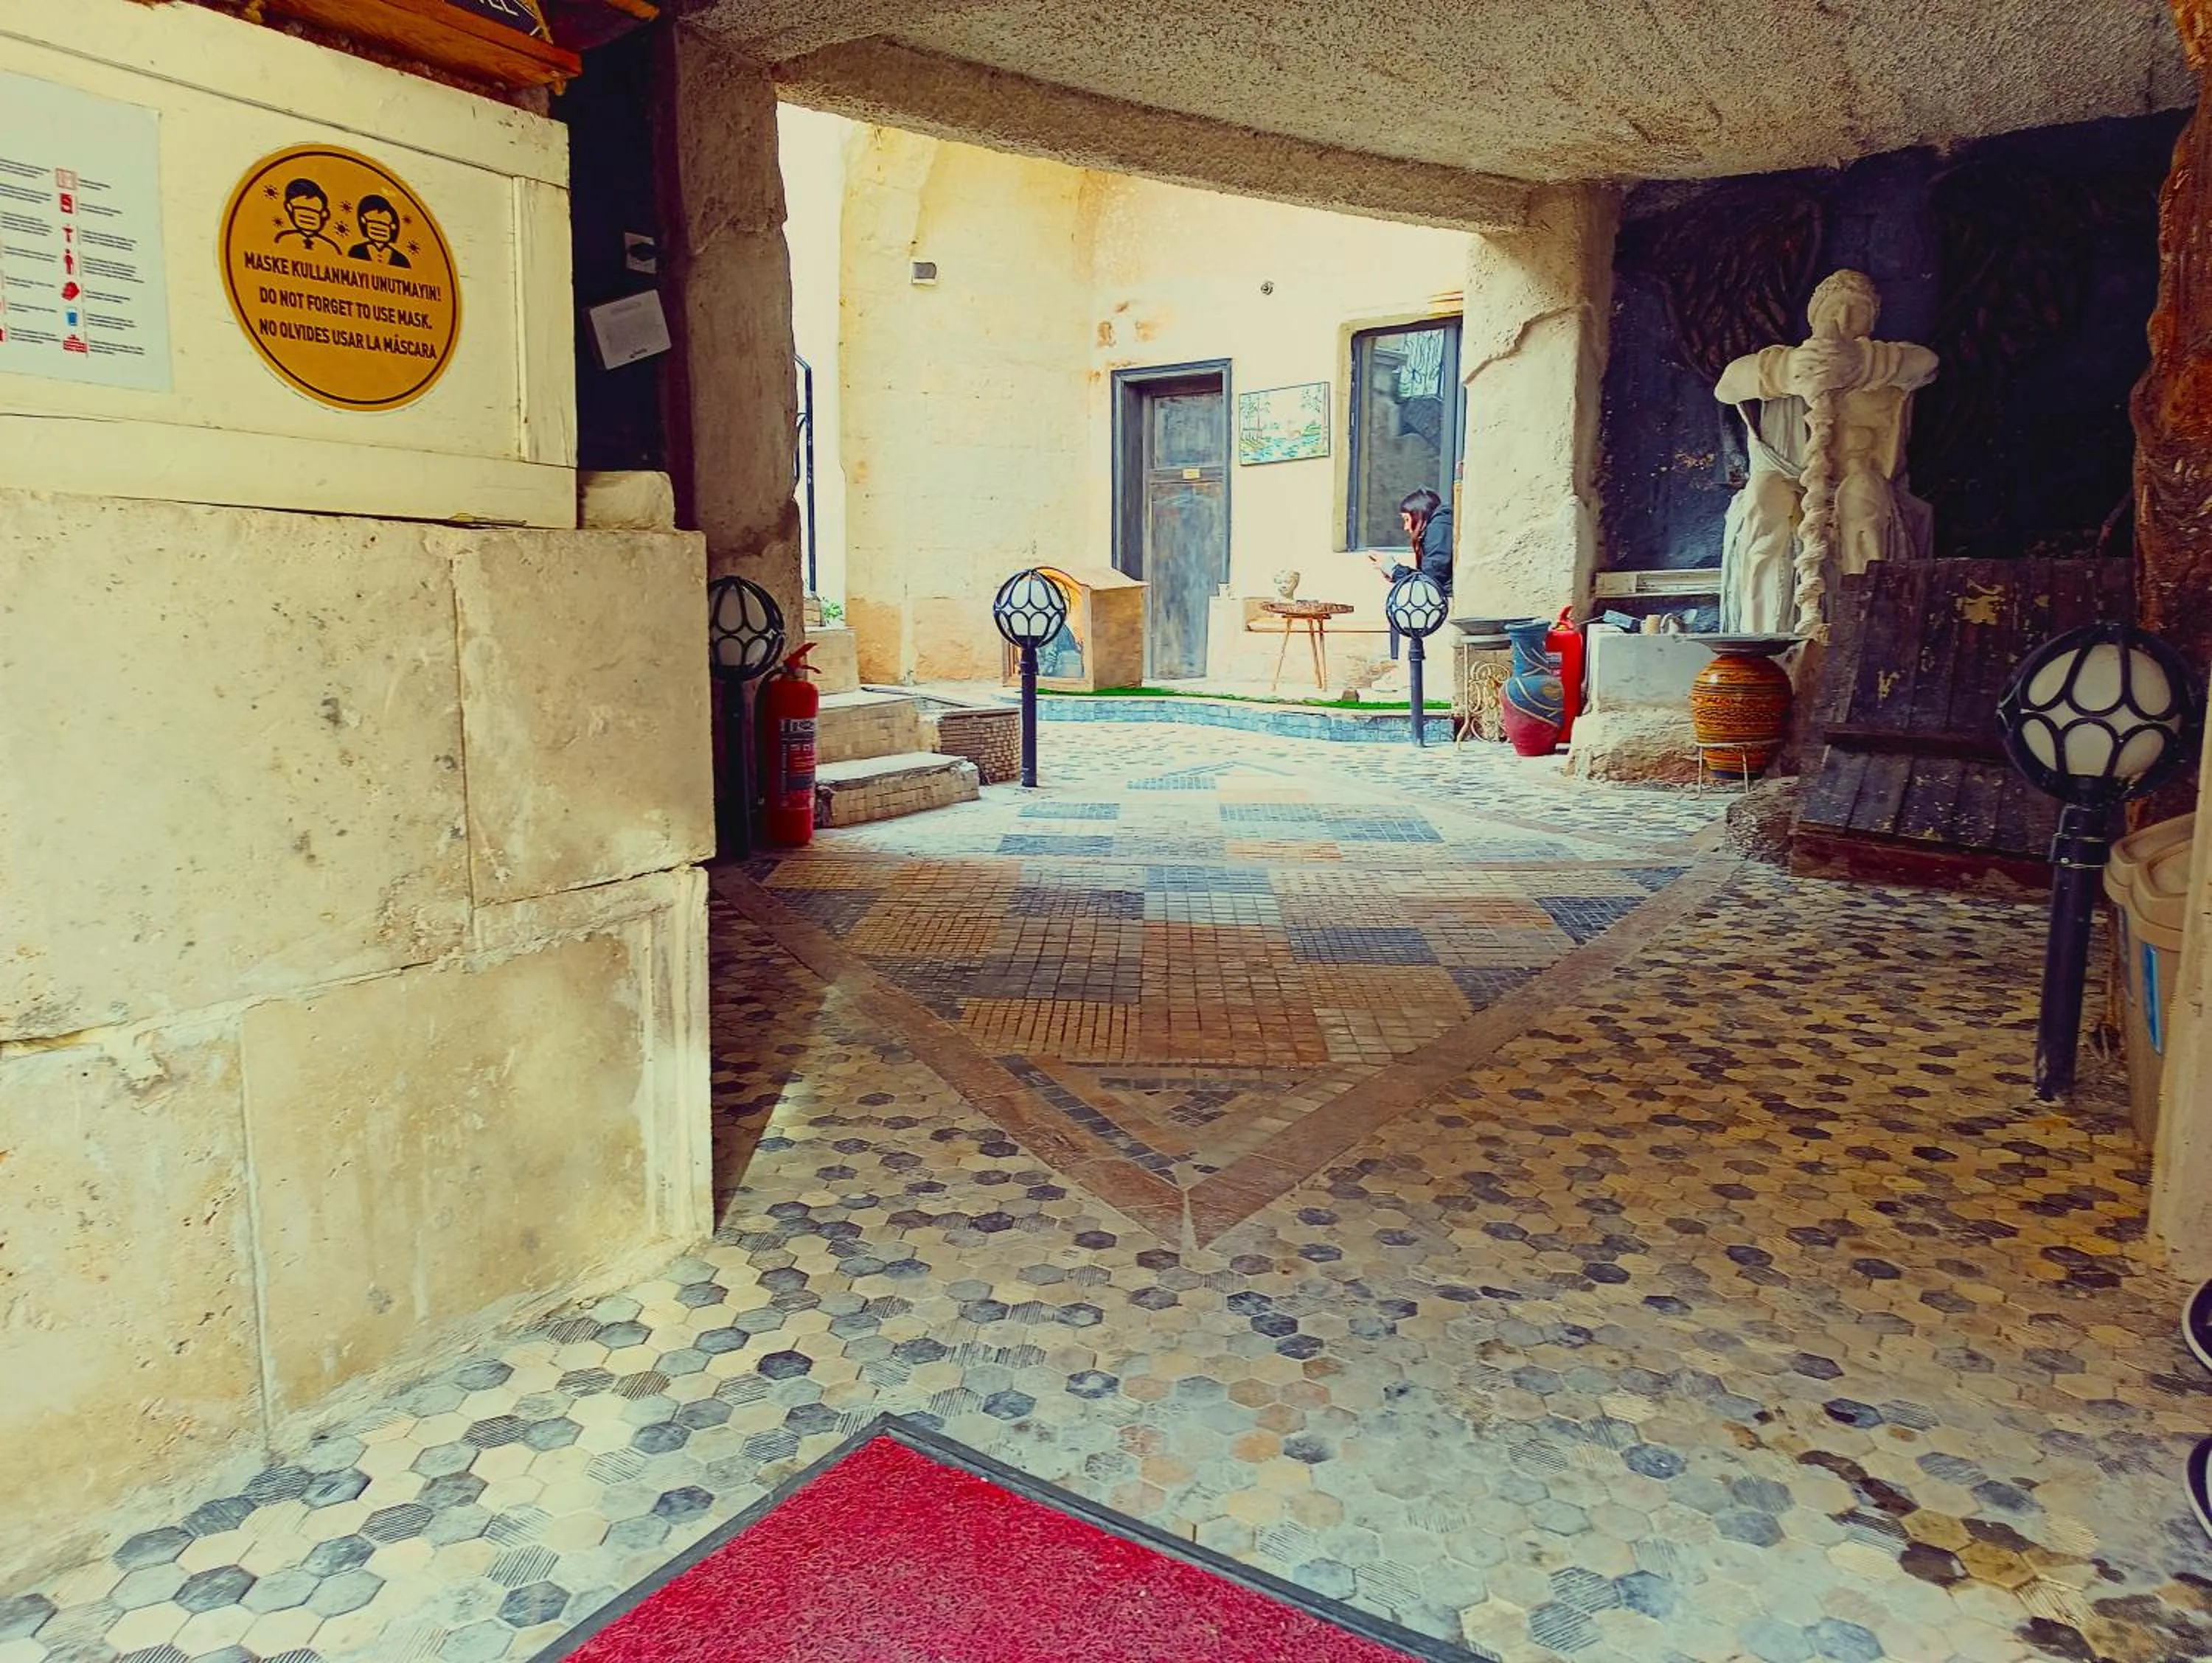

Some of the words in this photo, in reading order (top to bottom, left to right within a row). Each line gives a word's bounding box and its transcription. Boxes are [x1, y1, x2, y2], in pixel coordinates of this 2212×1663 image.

[244, 251, 289, 275] MASKE
[291, 260, 369, 290] KULLANMAYI
[371, 273, 441, 301] UNUTMAYIN!
[260, 286, 276, 304] DO
[279, 289, 304, 309] NOT
[307, 294, 353, 318] FORGET
[355, 301, 370, 319] TO
[372, 304, 395, 324] USE
[397, 308, 432, 330] MASK.
[260, 318, 276, 336] NO
[280, 321, 330, 344] OLVIDES
[332, 330, 364, 349] USAR
[366, 334, 381, 352] LA
[383, 333, 437, 360] MÁSCARA
